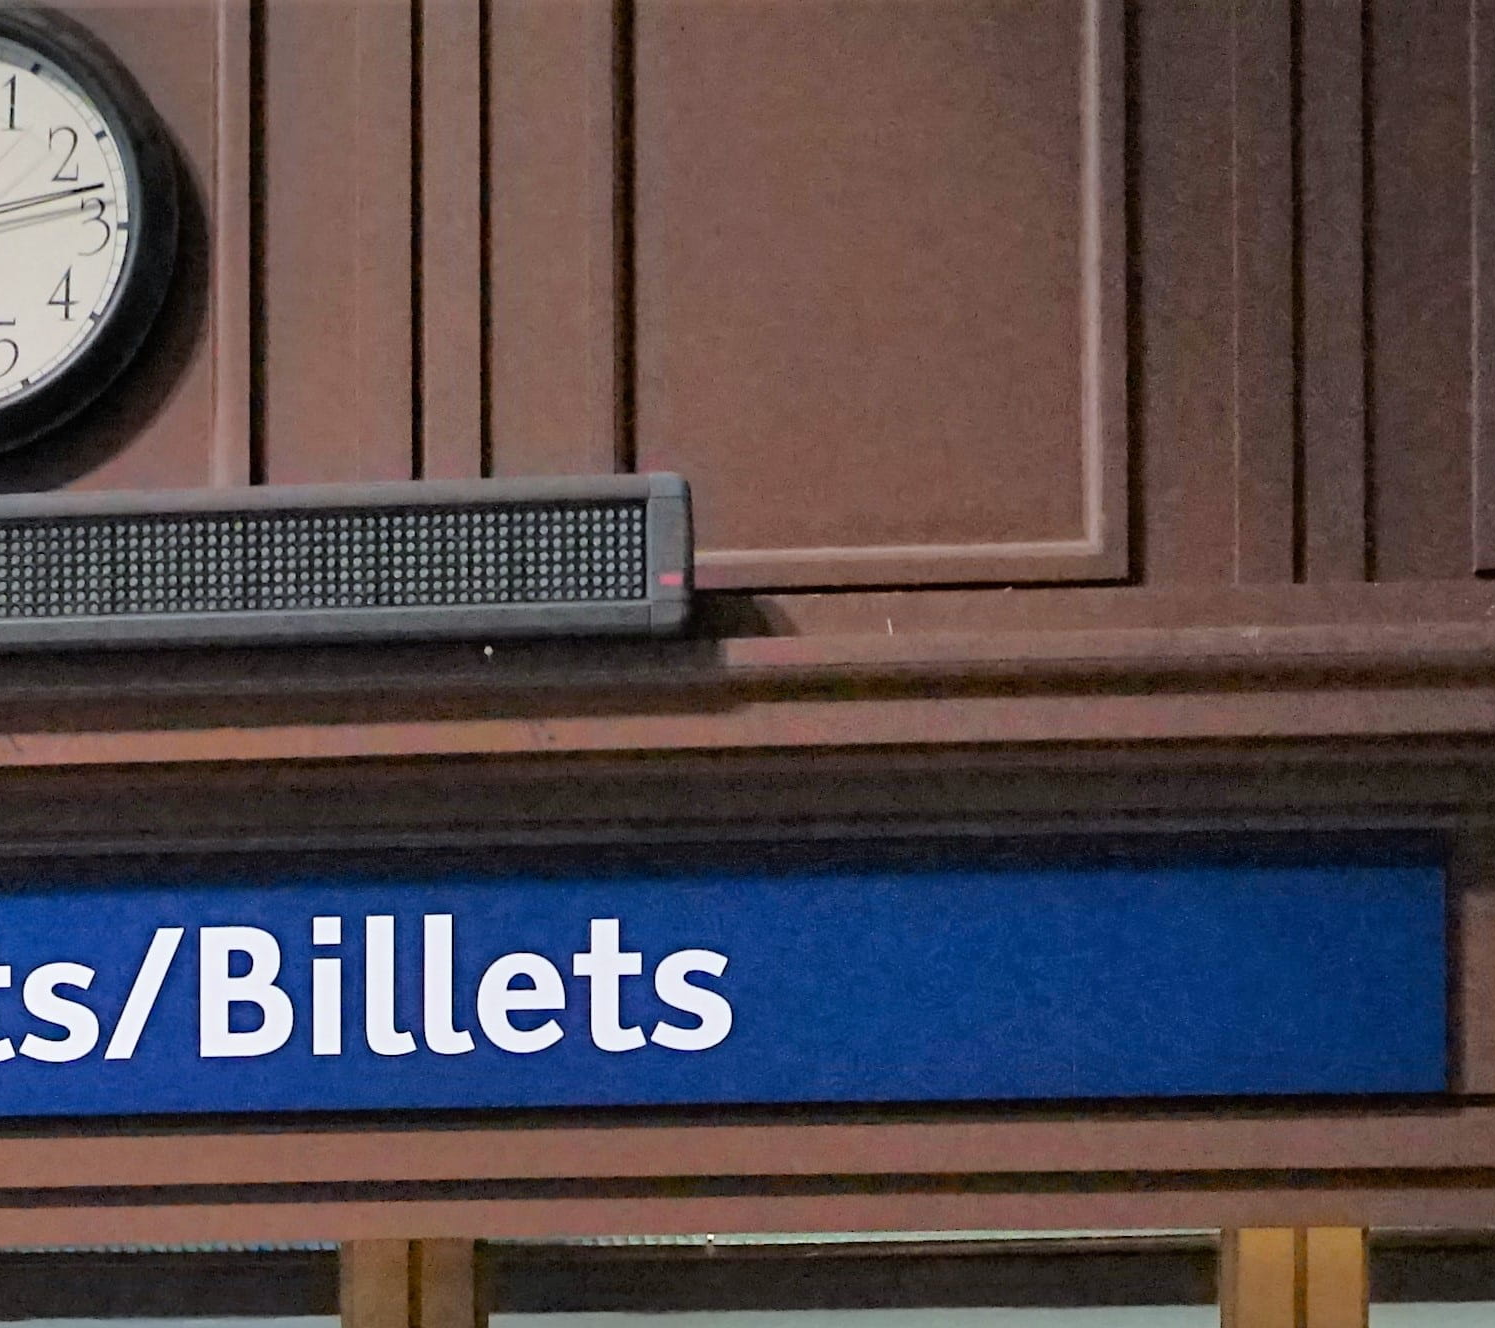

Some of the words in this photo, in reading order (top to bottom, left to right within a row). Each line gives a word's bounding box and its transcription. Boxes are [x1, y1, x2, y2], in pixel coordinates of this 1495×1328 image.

[3, 74, 23, 130] 1
[48, 126, 80, 182] 2
[78, 197, 111, 256] 3
[47, 266, 78, 321] 4
